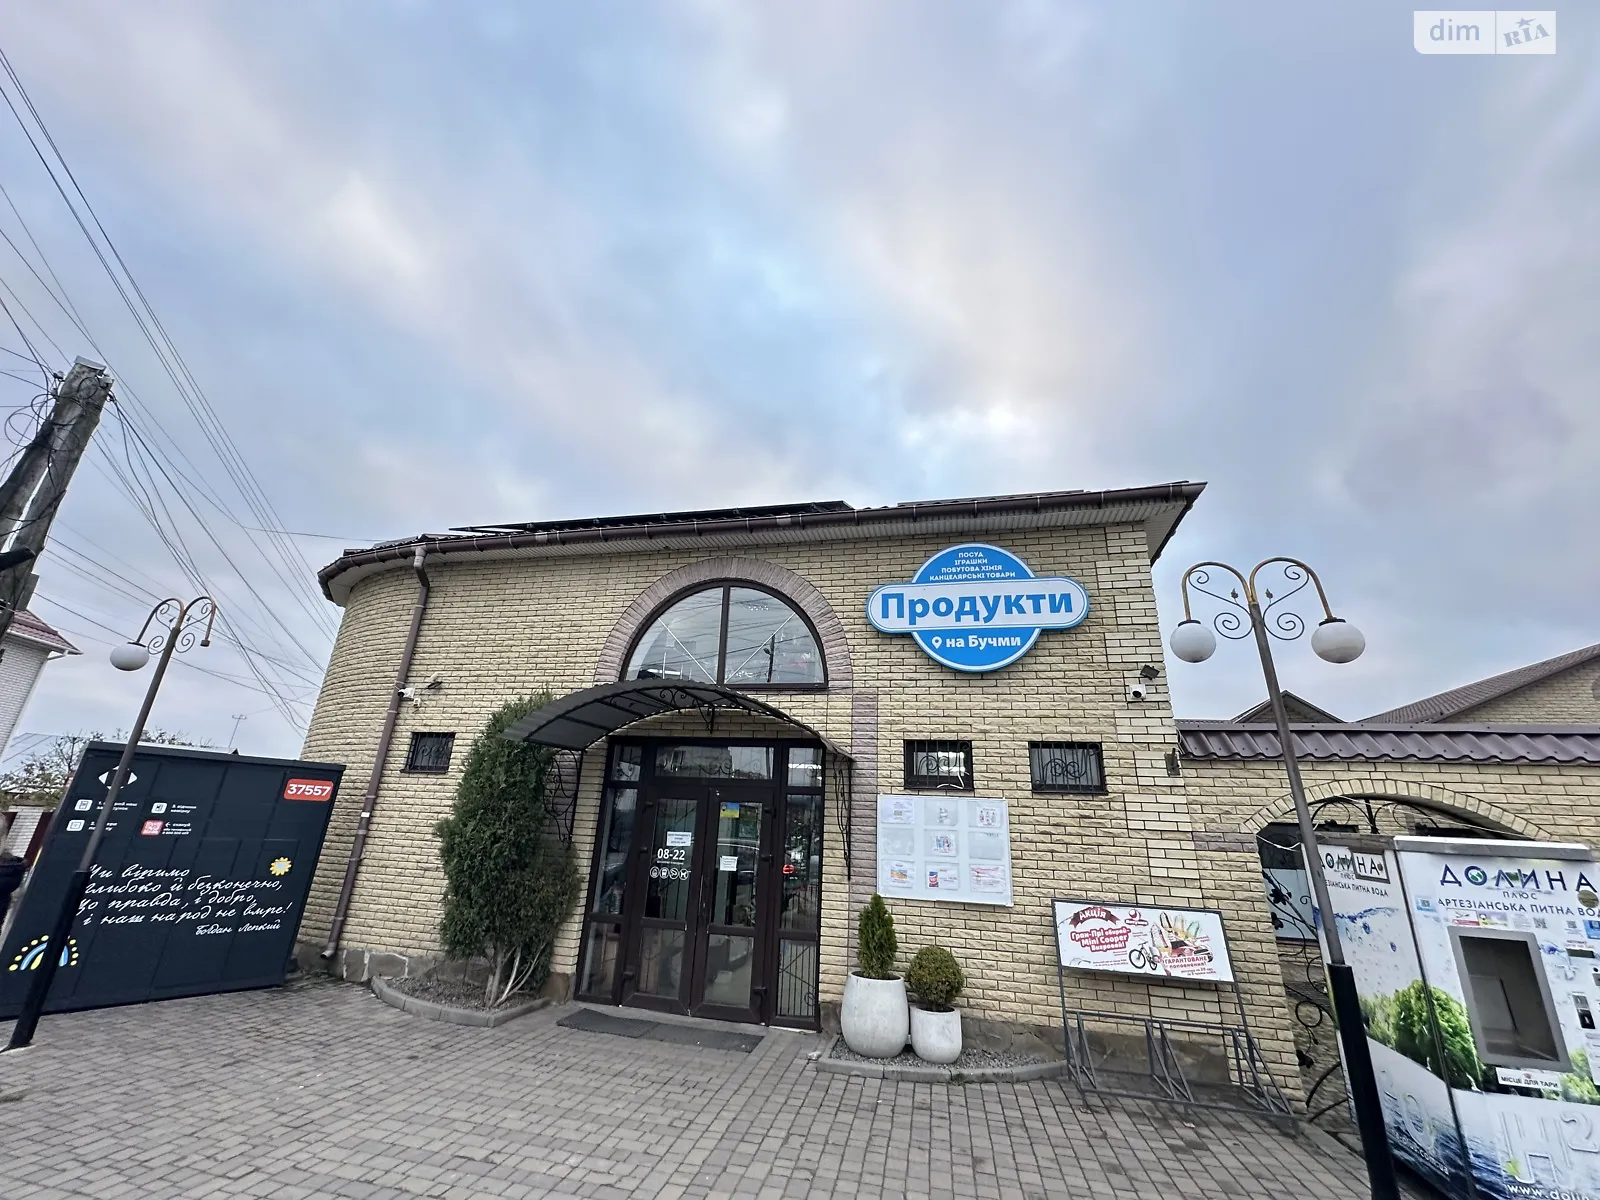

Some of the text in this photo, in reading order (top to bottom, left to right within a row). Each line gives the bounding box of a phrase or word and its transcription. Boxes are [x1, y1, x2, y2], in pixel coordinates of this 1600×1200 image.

[954, 558, 988, 566] ІГРАШКИ
[929, 573, 985, 581] КАНЦЕЛЯРСЬКІ
[881, 593, 1073, 626] Продукти
[946, 635, 1021, 651] на Бучми
[287, 783, 331, 797] 37557
[657, 848, 686, 861] 08-22
[121, 863, 190, 879] віримо
[1440, 863, 1598, 894] ДОЛИНА
[169, 877, 184, 892] й
[187, 874, 283, 897] безконечно,
[207, 887, 257, 906] добро,
[1503, 891, 1538, 900] ПЛЮС
[83, 913, 94, 926] і
[100, 914, 146, 925] наш
[214, 908, 237, 918] не
[242, 901, 293, 919] вмре!
[1438, 898, 1527, 913] АРТЕЗІАНСЬКА
[1530, 903, 1575, 916] ПИТНА
[1100, 934, 1128, 945] Cooper
